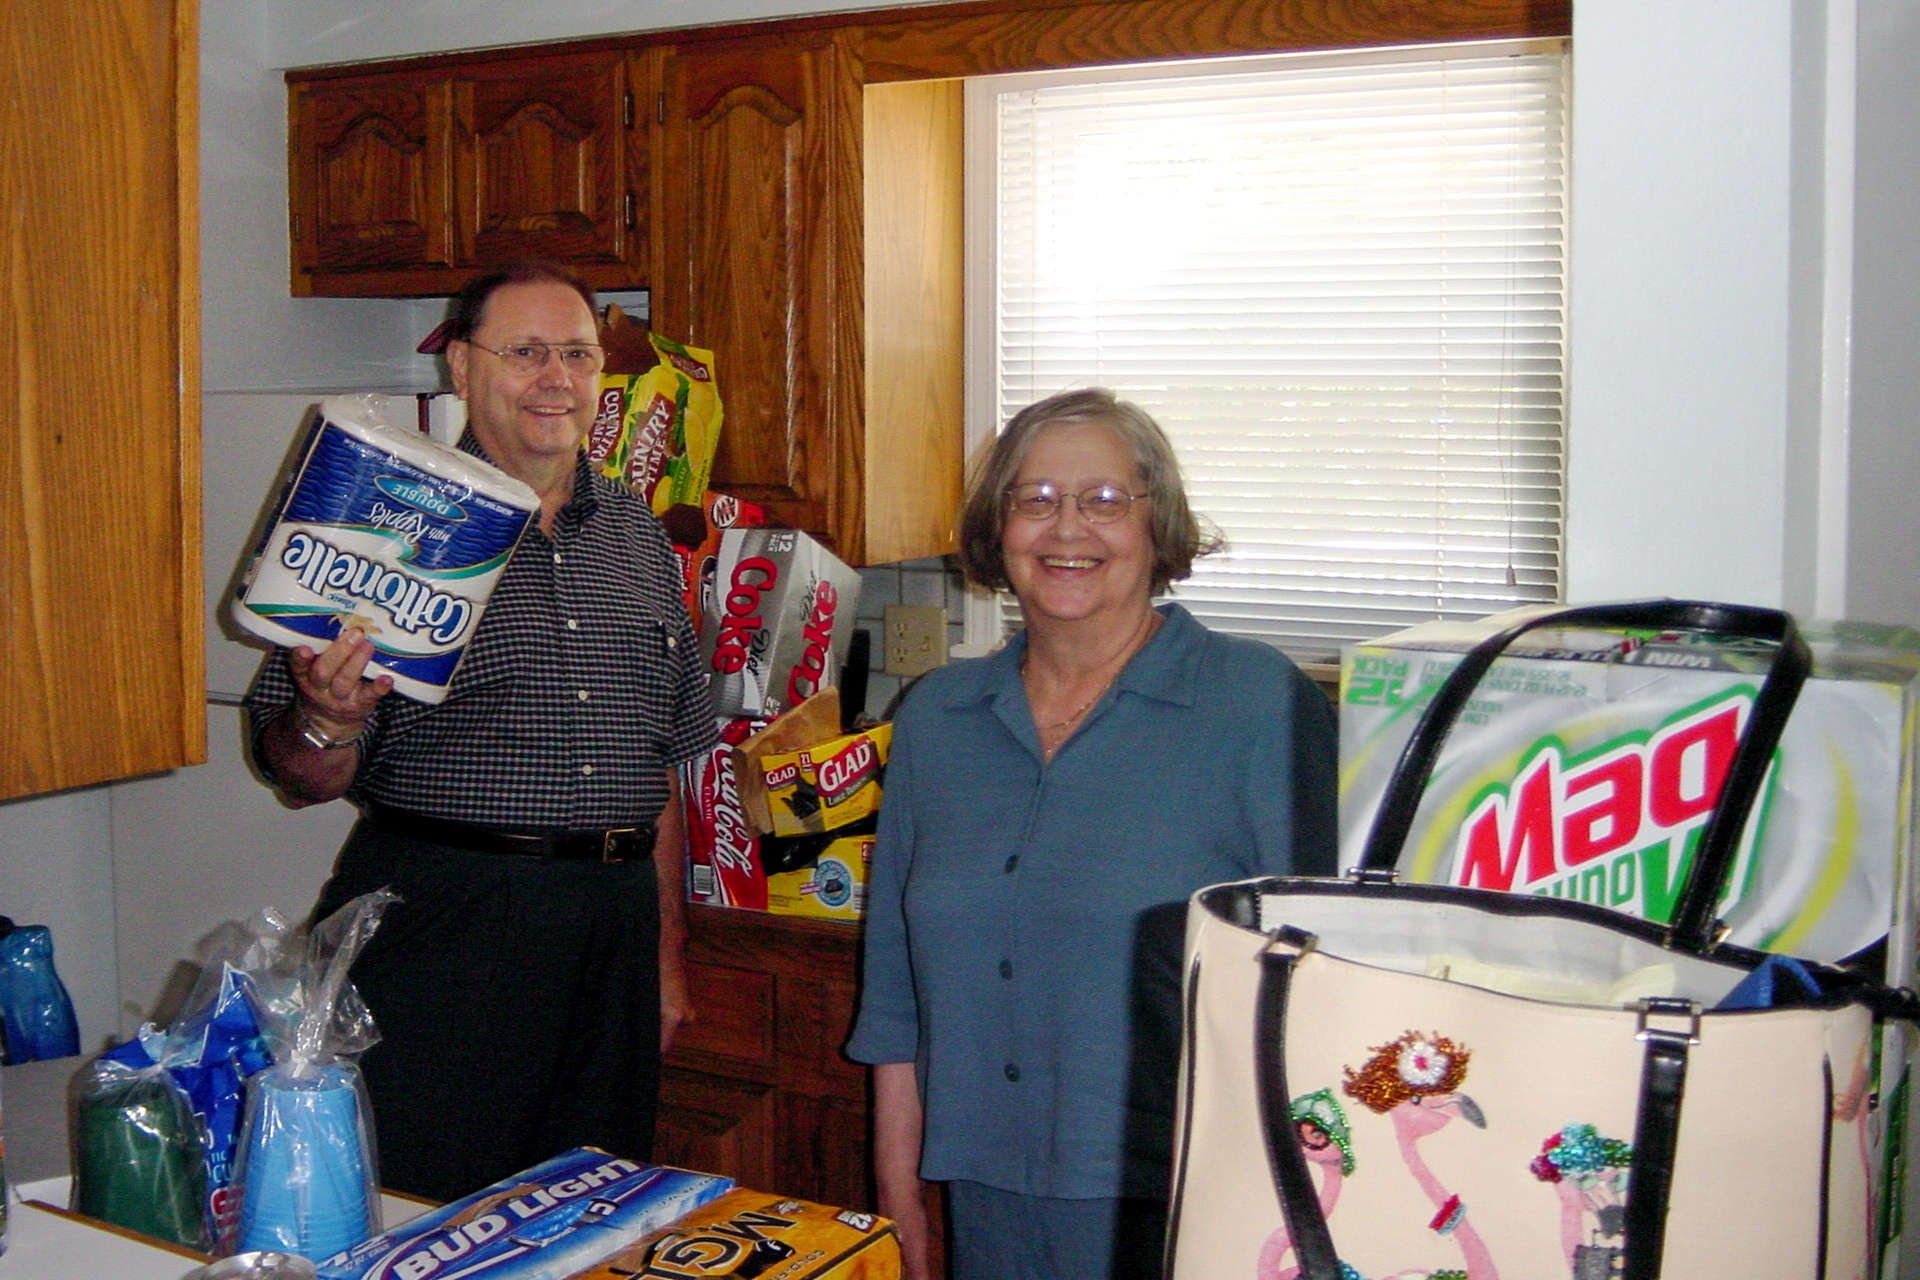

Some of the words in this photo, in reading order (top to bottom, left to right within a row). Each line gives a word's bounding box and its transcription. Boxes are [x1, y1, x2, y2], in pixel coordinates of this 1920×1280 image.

[645, 435, 668, 484] TIME
[391, 483, 450, 516] DOUBLE
[369, 501, 425, 546] Ripples
[778, 533, 794, 553] 12
[281, 532, 472, 645] Cottonelle
[711, 556, 778, 675] Coke
[787, 580, 838, 706] Coke
[1643, 651, 1711, 669] WIN
[1353, 658, 1409, 678] PACK
[1346, 678, 1404, 707] 12
[766, 766, 796, 785] GLAD
[819, 743, 871, 792] GLAD
[703, 786, 713, 821] CLASSIC
[392, 1213, 507, 1280] BUD
[513, 1160, 642, 1219] LIGHT
